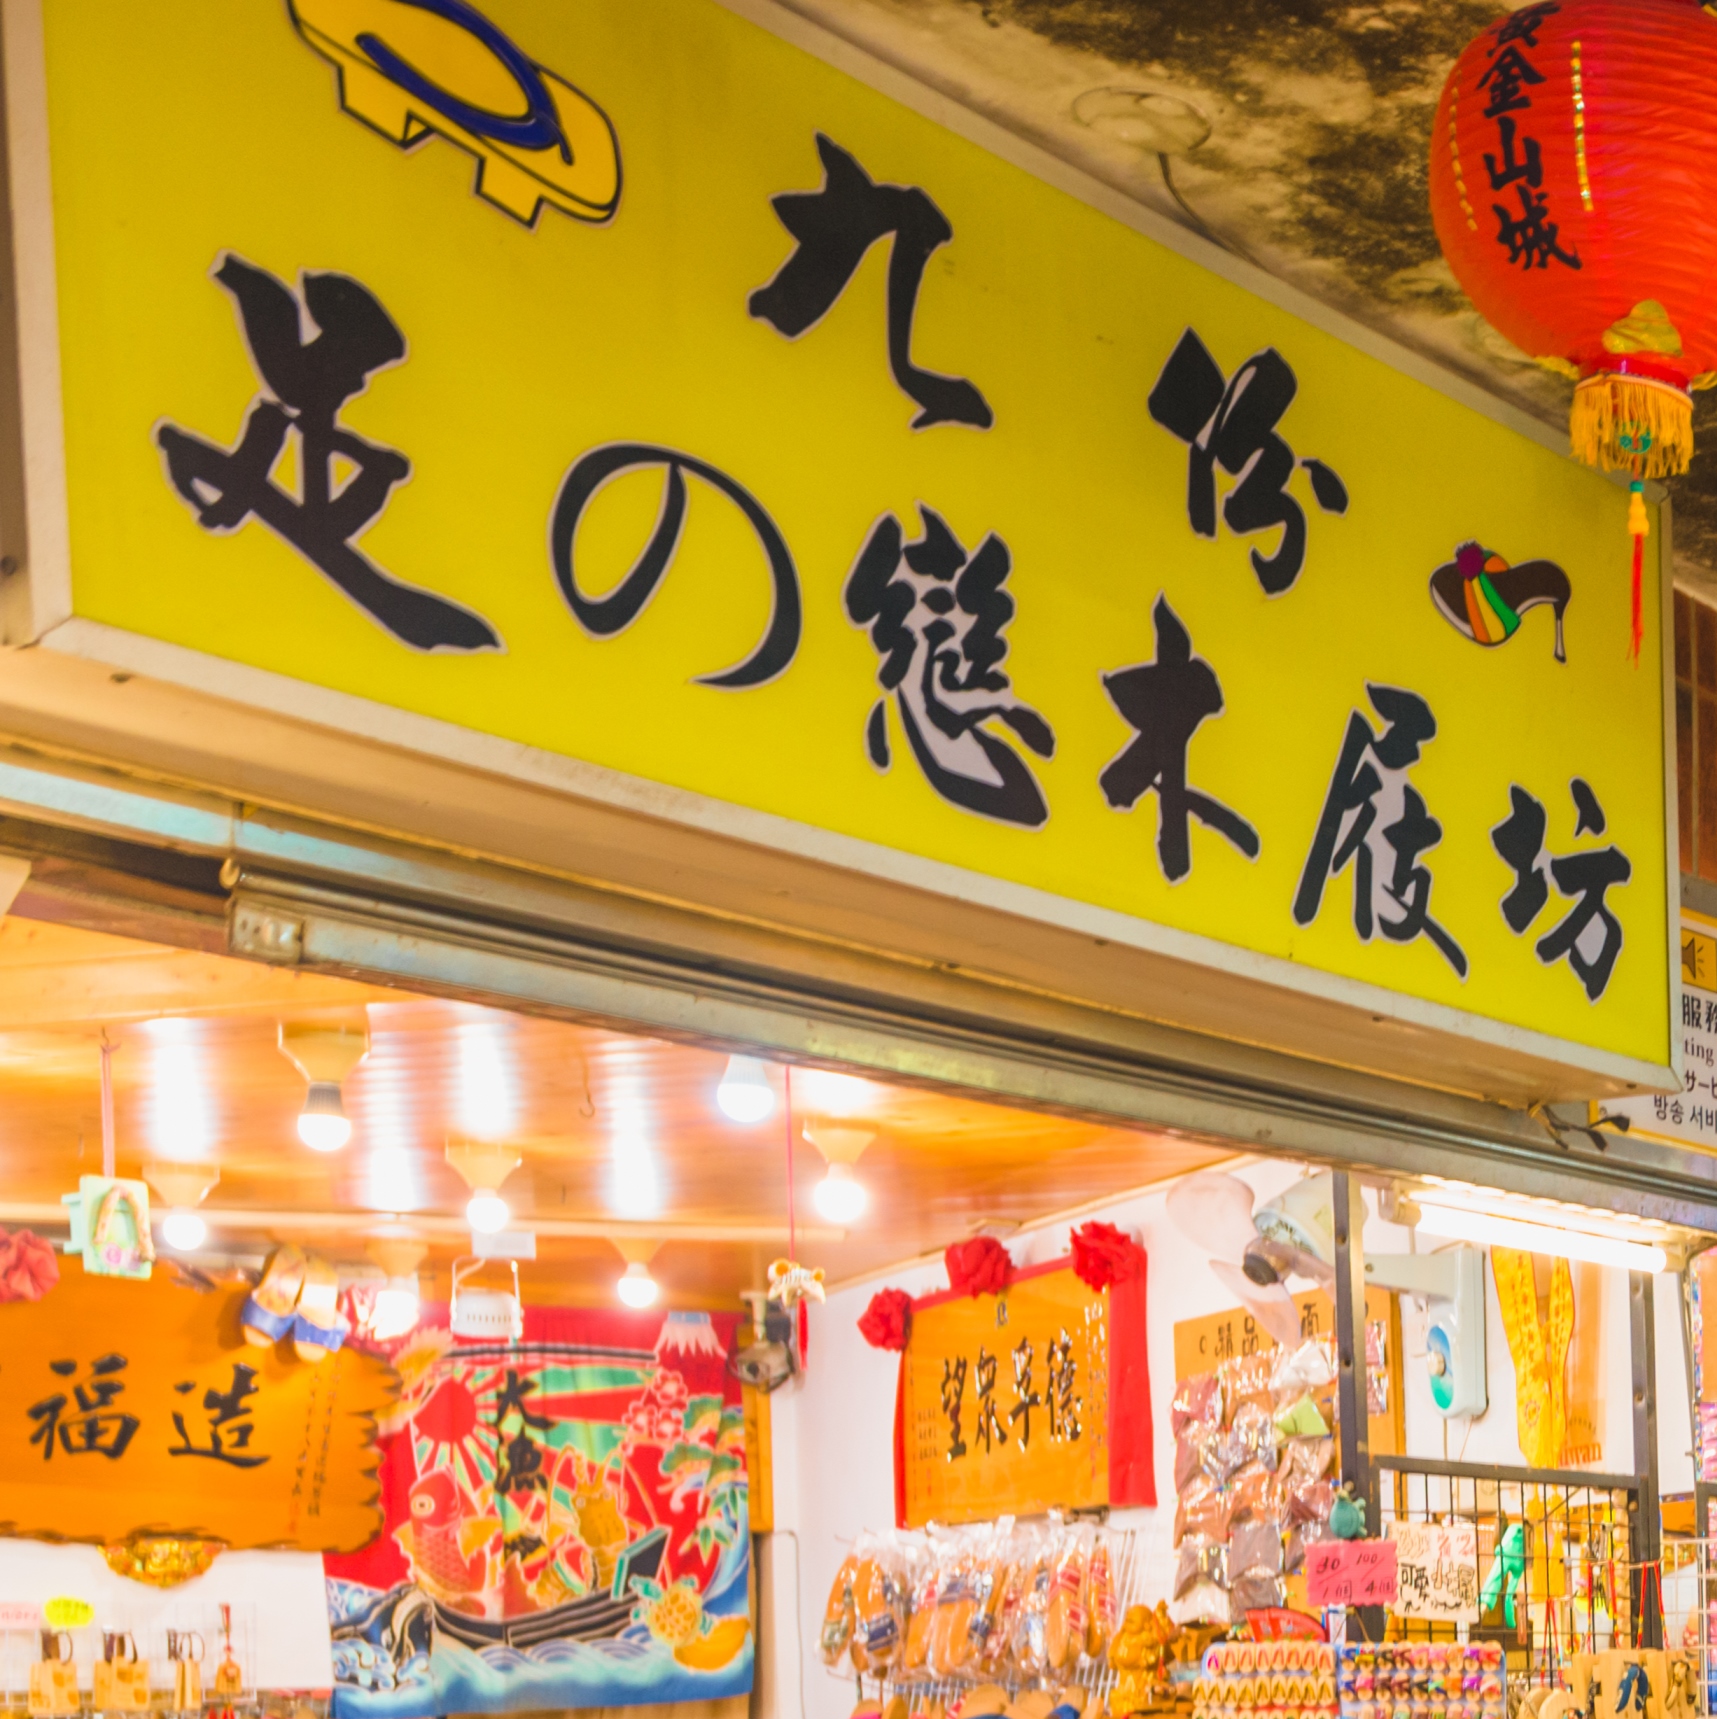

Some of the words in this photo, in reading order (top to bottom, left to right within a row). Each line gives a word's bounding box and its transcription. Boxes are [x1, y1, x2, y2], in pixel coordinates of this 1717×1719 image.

[746, 130, 1352, 600] 九份
[153, 250, 1634, 1003] 足の戀木屐坊
[1654, 1096, 1684, 1125] 방송
[1684, 1038, 1714, 1067] ting
